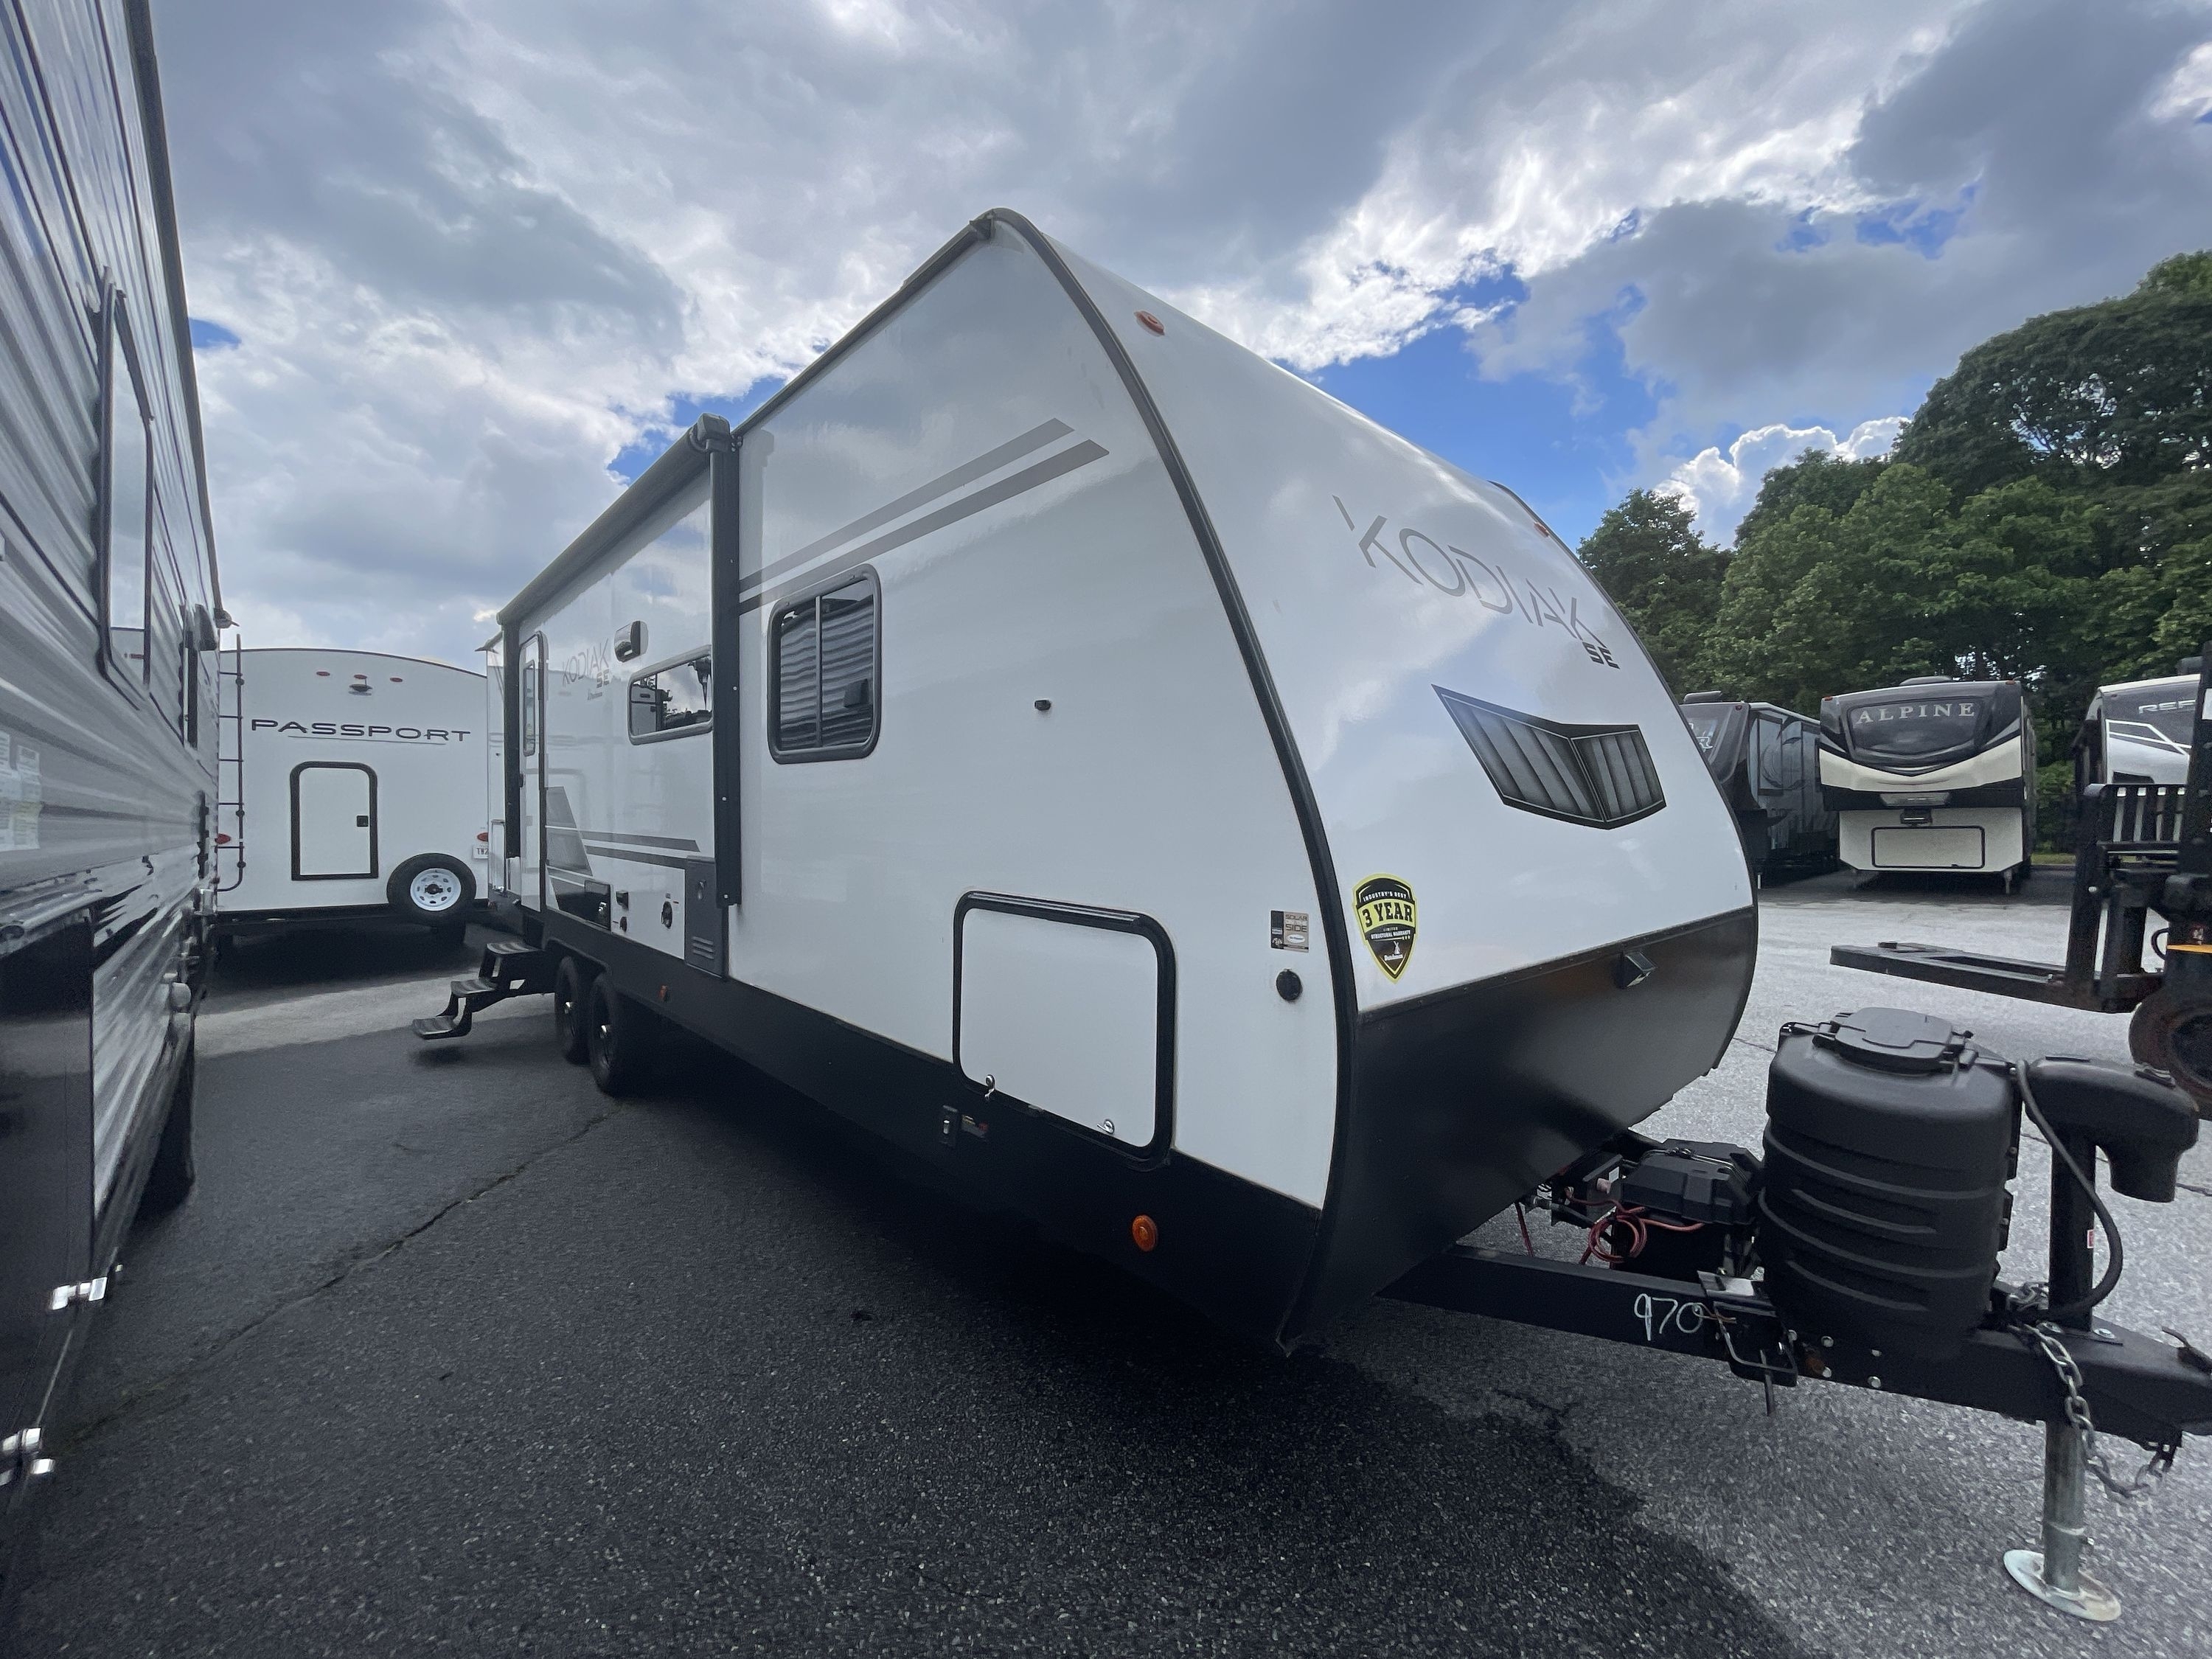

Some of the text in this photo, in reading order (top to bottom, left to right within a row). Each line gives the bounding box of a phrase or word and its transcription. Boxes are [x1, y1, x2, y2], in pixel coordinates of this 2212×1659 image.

[1332, 494, 1607, 649] KODIAK
[562, 638, 609, 687] KODIAK
[1582, 642, 1621, 669] SE
[596, 669, 610, 689] SE
[1856, 703, 1975, 725] ALPINE
[251, 719, 471, 742] PASSPORT
[1363, 891, 1407, 902] INDUSTRY'S BEST
[1362, 902, 1413, 928] 3 YEAR
[1285, 923, 1307, 933] SIDE
[1634, 1293, 1704, 1341] 970
